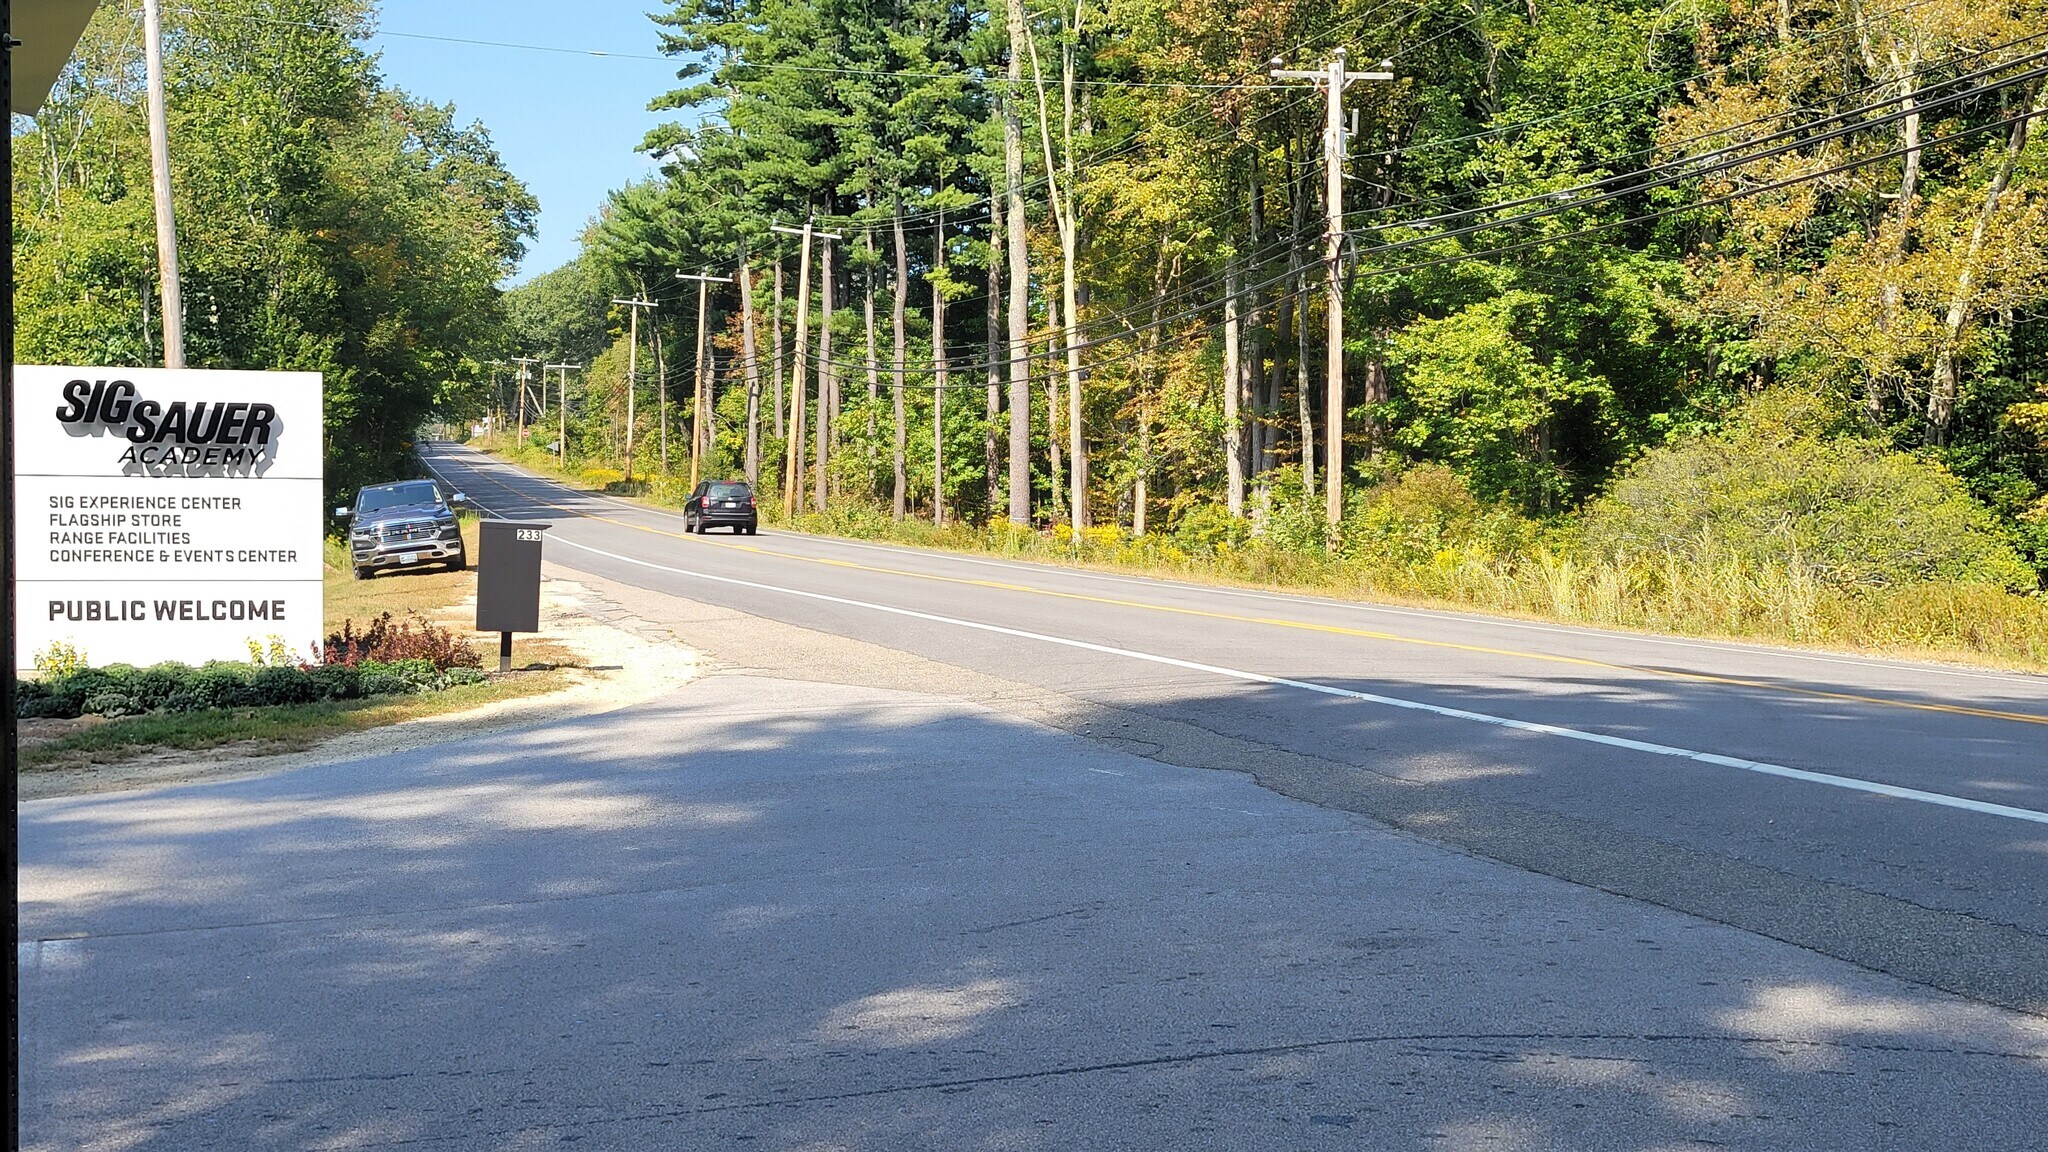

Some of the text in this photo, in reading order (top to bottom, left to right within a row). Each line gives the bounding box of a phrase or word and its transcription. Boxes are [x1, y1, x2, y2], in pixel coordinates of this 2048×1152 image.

[56, 380, 275, 444] SIG SAUER
[118, 446, 265, 465] ACADEMY
[49, 496, 241, 509] SIG EXPERIENCE CENTER
[50, 514, 181, 526] FLAGSHIP STORE
[50, 532, 190, 544] RANGE FACILITIES
[518, 530, 540, 540] 233
[50, 550, 297, 562] CONFERENCE & EVENTS CENTER
[50, 601, 285, 621] PUBLIC WELCOME
